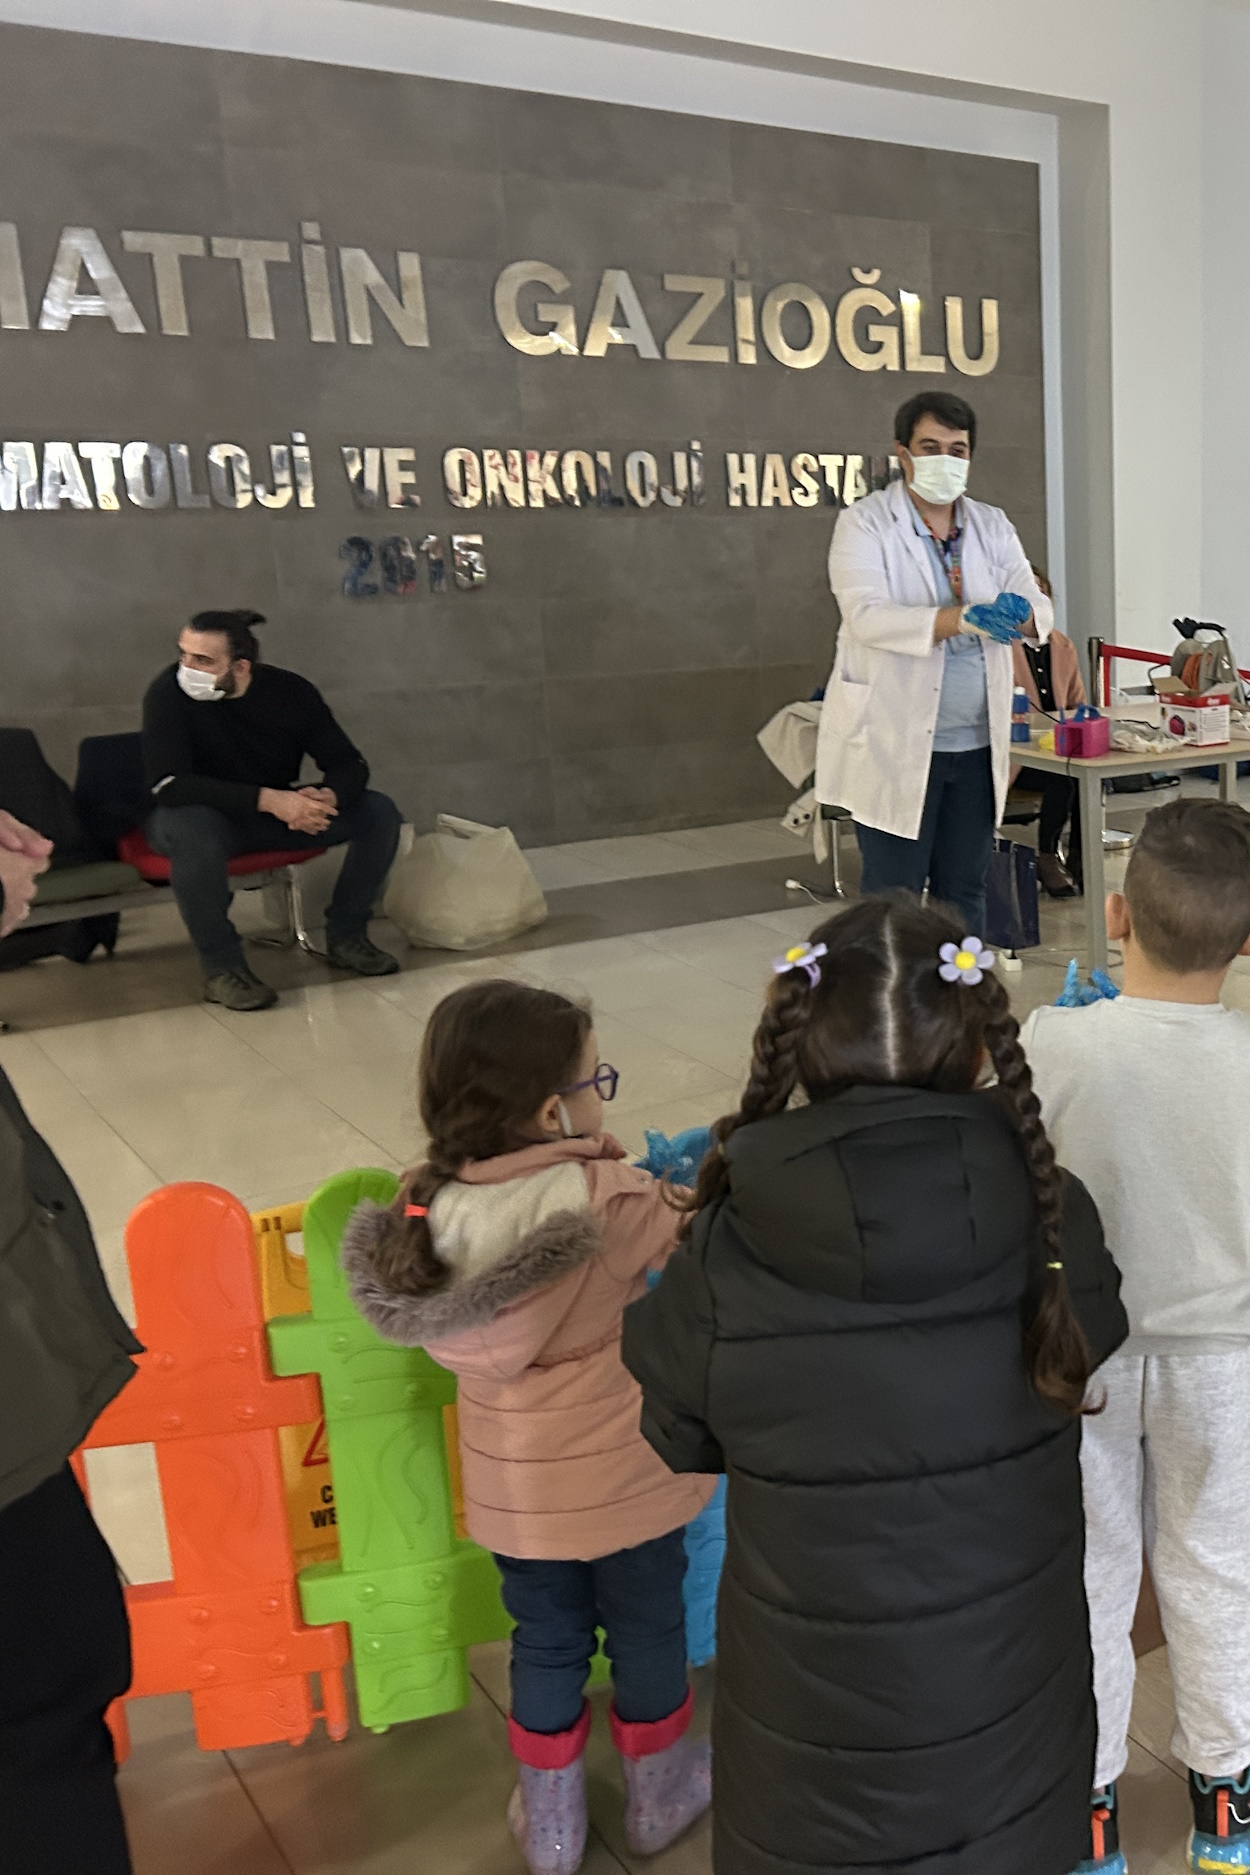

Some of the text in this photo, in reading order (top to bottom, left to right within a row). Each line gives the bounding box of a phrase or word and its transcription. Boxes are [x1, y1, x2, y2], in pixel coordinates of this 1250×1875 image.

[494, 260, 1000, 376] GAZİOĞLU
[341, 447, 421, 508] VE
[443, 440, 705, 509] ONKOLOJİ
[339, 533, 487, 598] 2015
